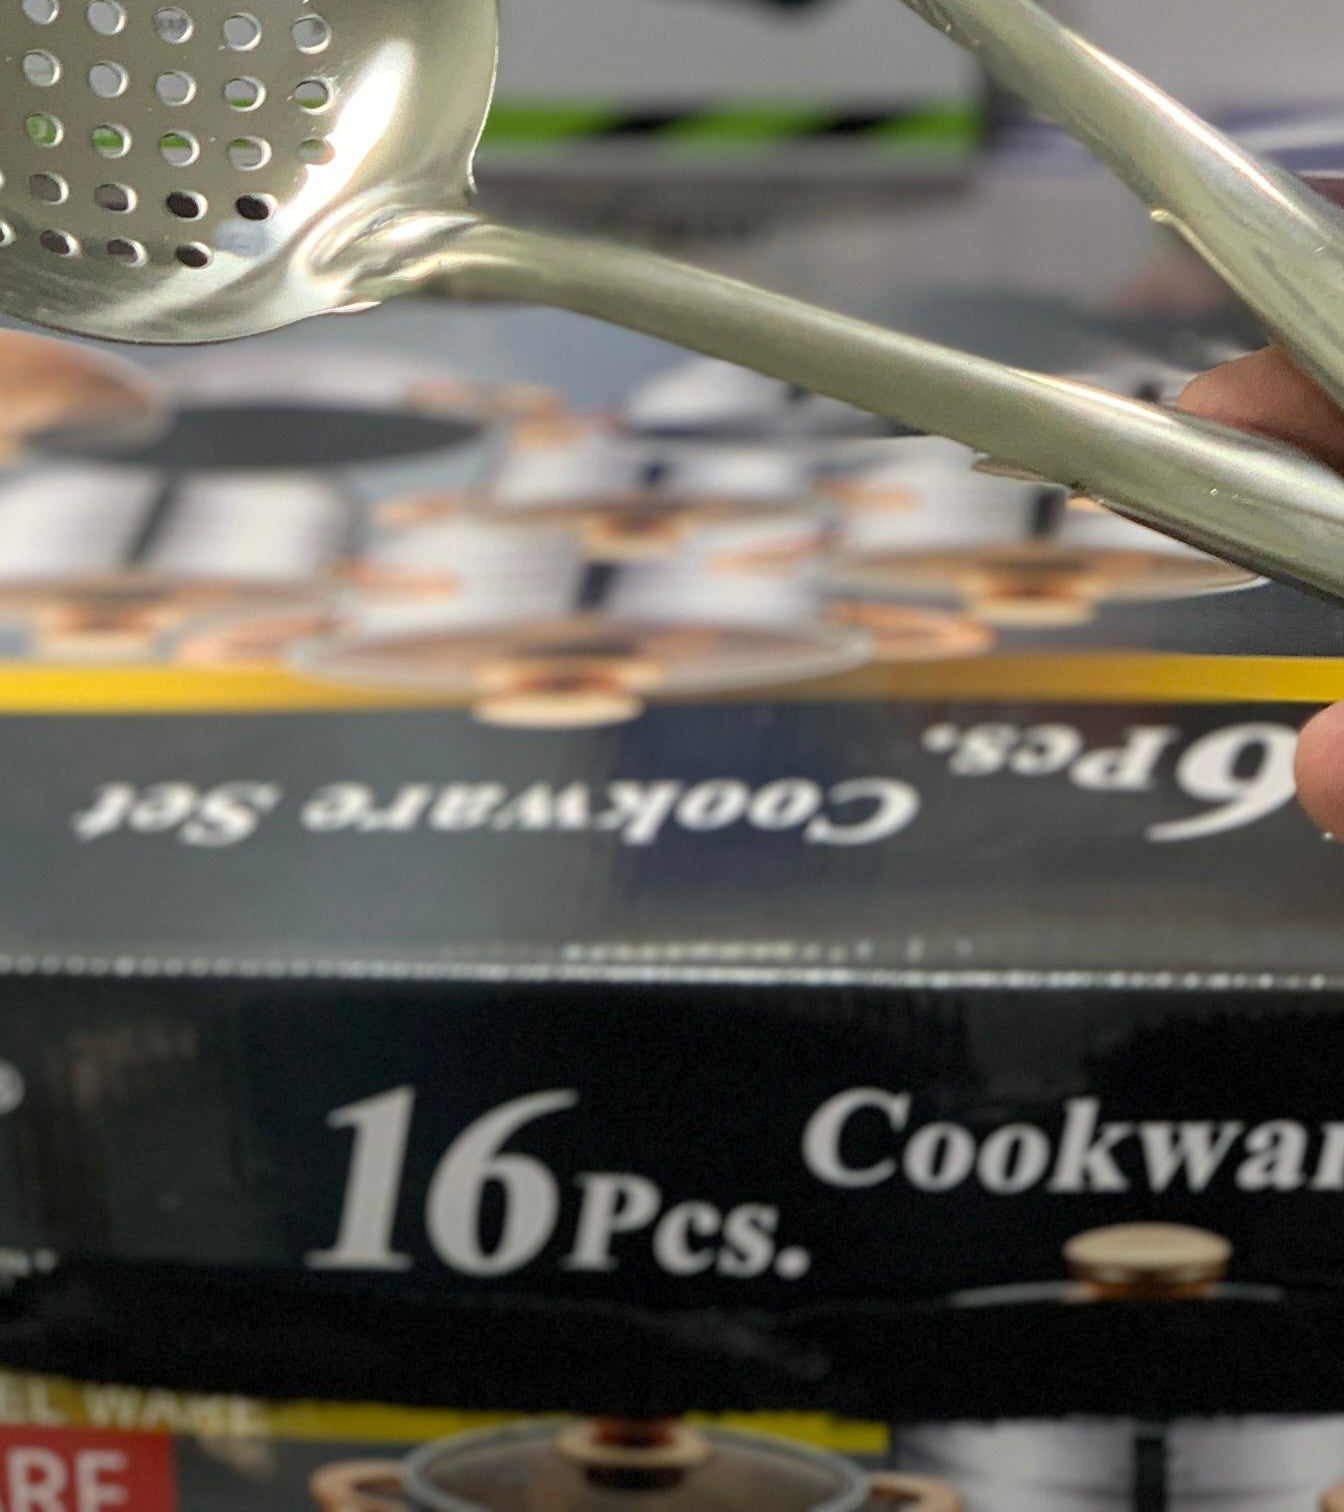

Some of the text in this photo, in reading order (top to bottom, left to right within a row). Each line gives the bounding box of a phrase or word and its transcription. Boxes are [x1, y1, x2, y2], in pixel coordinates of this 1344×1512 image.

[74, 779, 278, 846] Set
[301, 777, 919, 846] Cookware
[1143, 720, 1299, 844] 6
